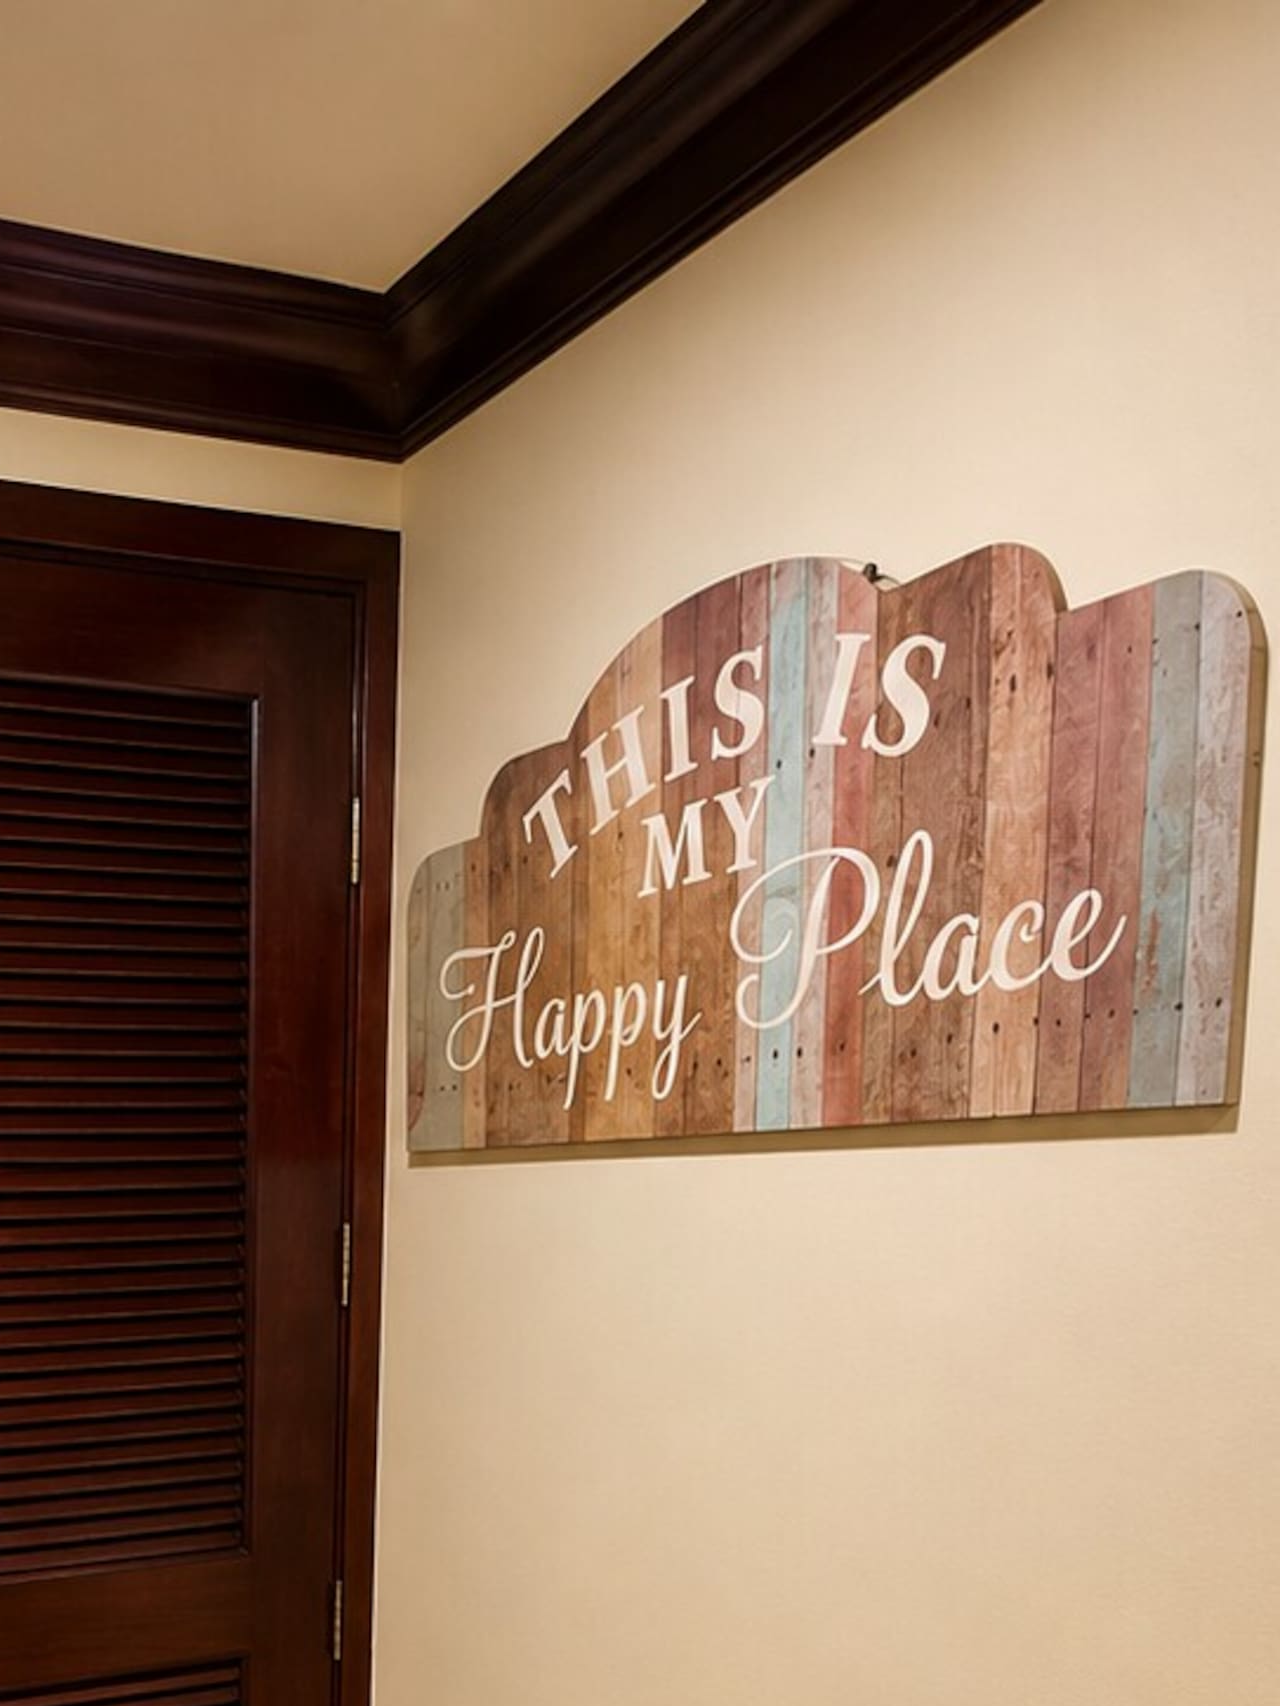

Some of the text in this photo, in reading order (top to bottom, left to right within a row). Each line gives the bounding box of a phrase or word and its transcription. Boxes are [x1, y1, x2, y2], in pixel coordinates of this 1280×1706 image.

[522, 633, 946, 879] THIS IS
[637, 775, 775, 899] MY
[439, 830, 1127, 1110] Happy Place
